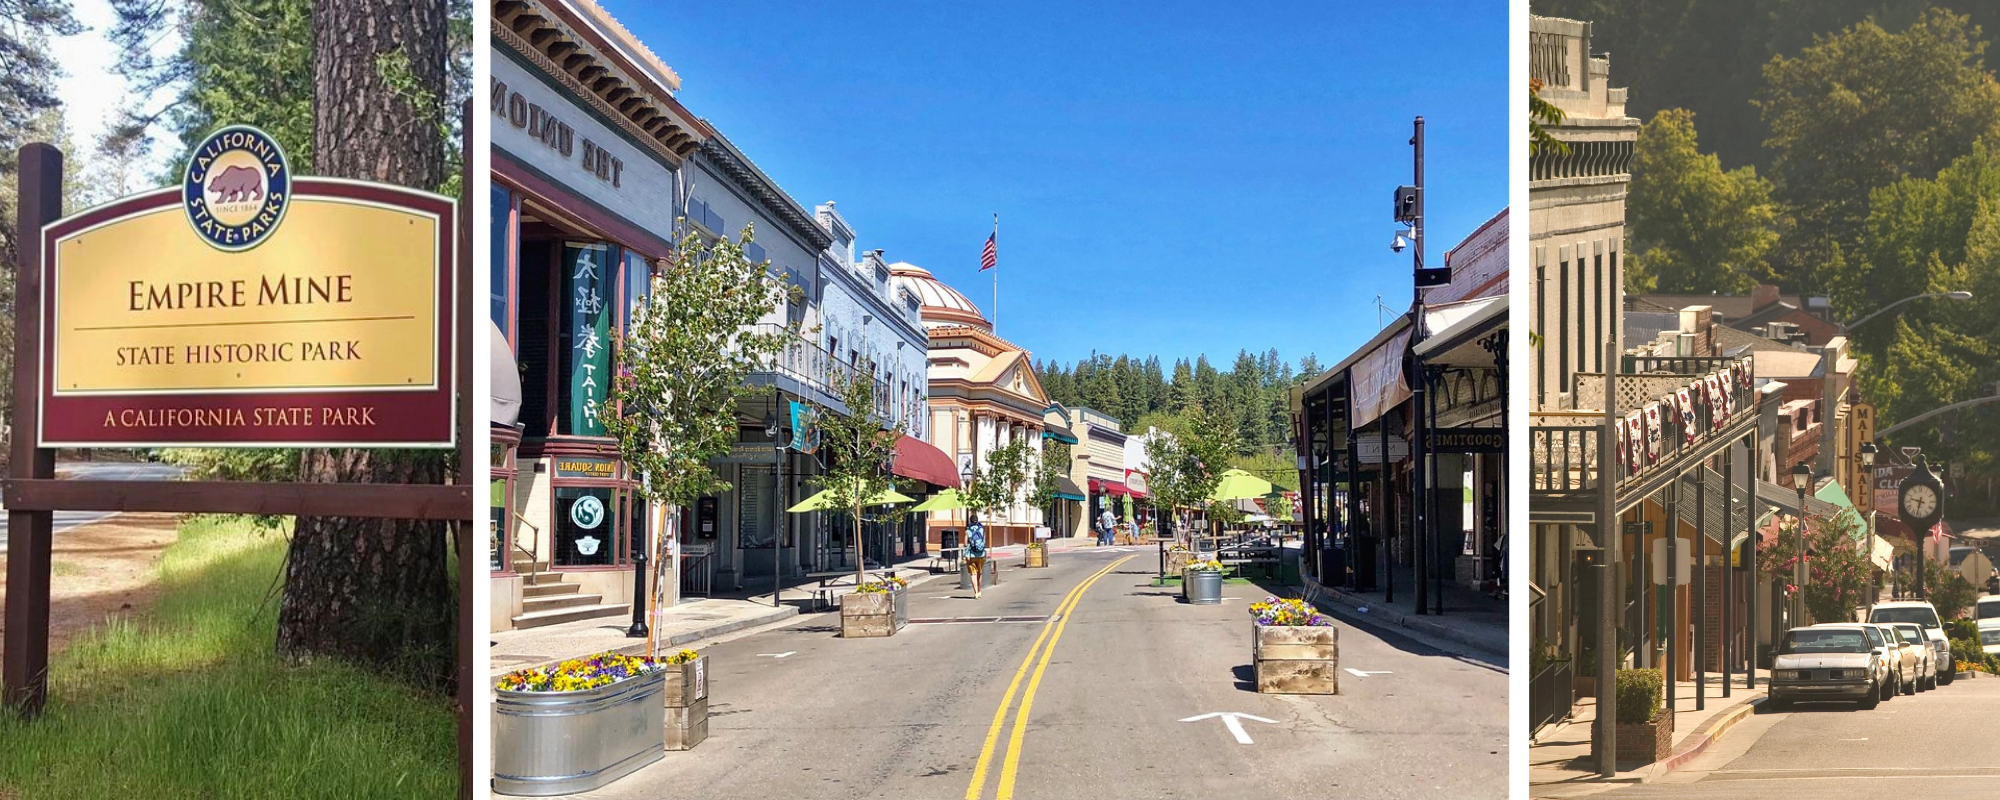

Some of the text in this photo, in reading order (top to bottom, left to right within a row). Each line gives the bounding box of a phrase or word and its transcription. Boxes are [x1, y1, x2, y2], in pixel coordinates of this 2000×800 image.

[191, 132, 281, 184] CALIFORNIA
[190, 192, 282, 243] STATE PARKS
[128, 274, 353, 312] EMPIRE MINE
[117, 340, 362, 366] STATE HISTORIC PARK
[104, 407, 376, 427] A CALIFORNIA STATE PARK
[1879, 479, 1900, 489] CLU
